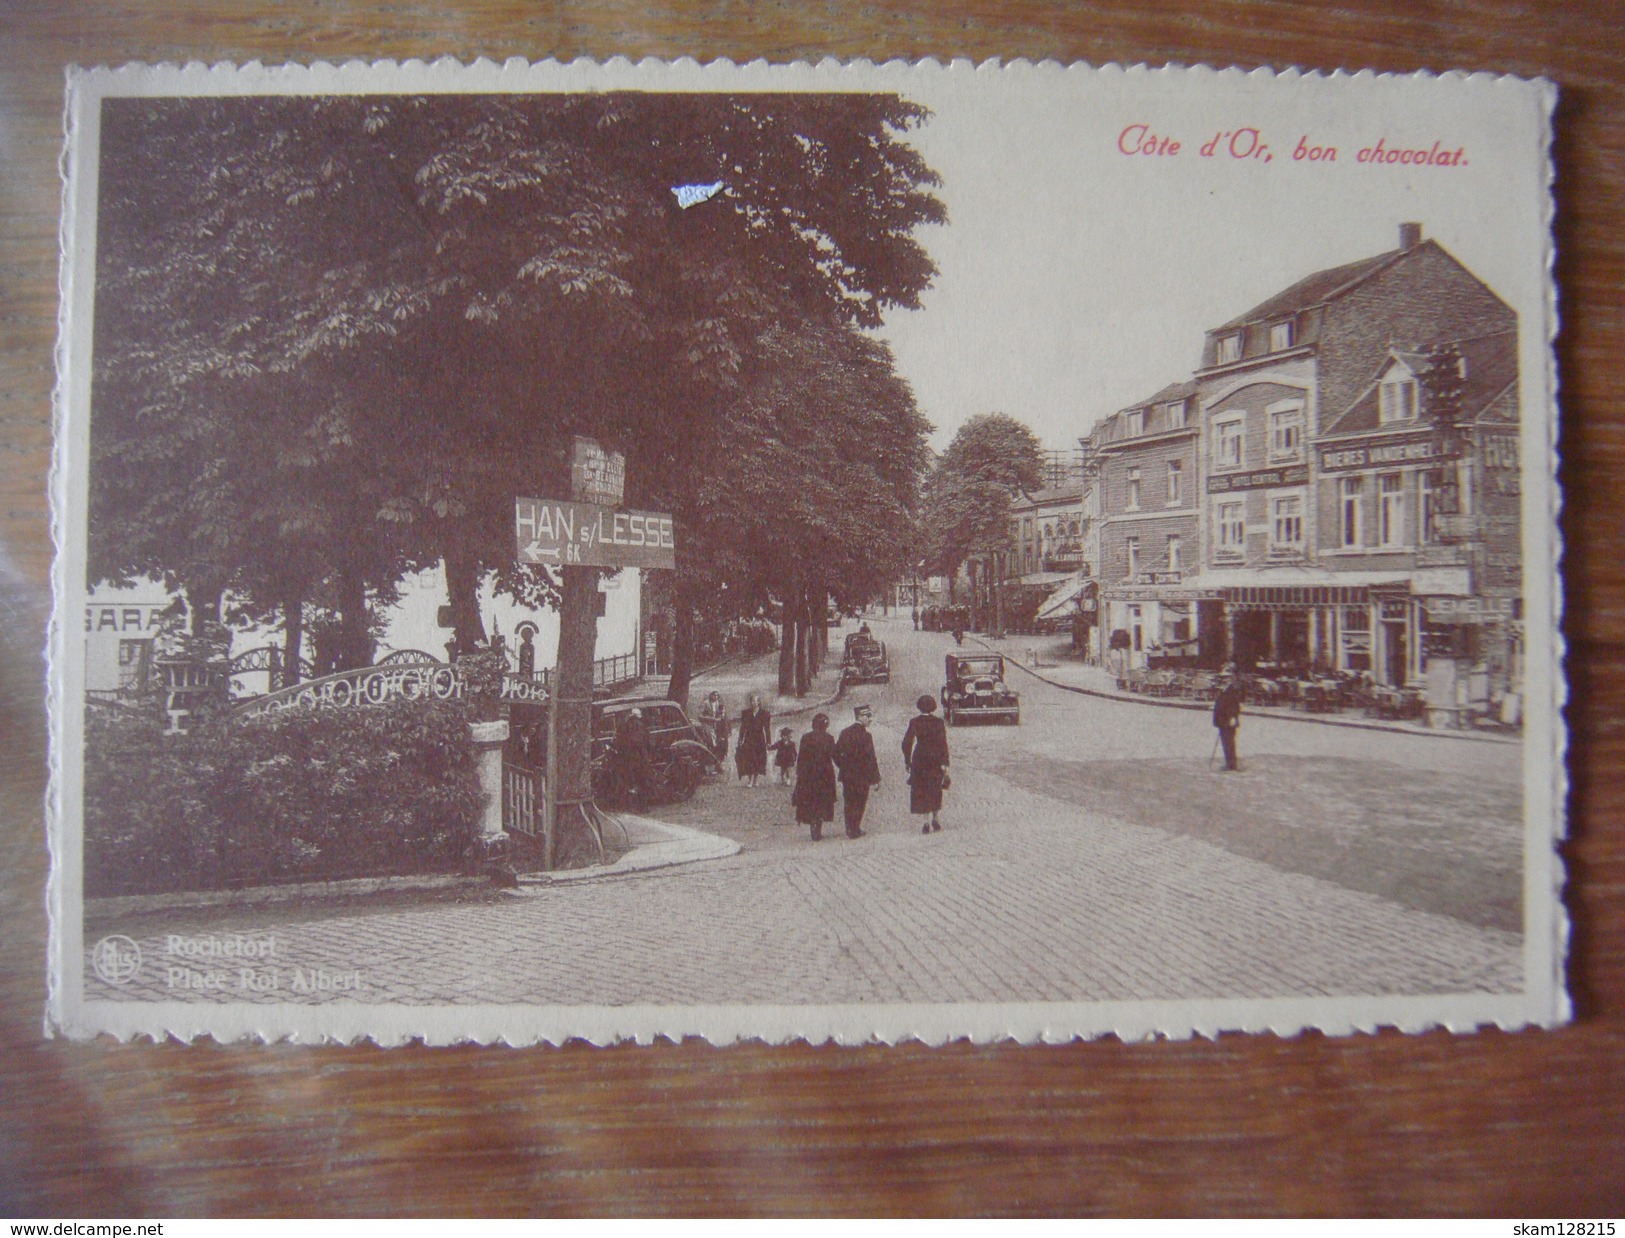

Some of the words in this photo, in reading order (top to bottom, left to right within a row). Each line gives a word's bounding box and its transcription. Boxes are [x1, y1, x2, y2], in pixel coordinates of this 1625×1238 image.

[1117, 123, 1182, 156] Côte
[1200, 127, 1274, 164] d'Or,
[1292, 135, 1338, 162] bon
[1356, 137, 1470, 168] chocolat.
[515, 503, 575, 541] HAN
[166, 934, 278, 957] Rochefort
[167, 967, 226, 989] Place
[239, 968, 279, 990] Roi
[290, 969, 361, 990] Albert
